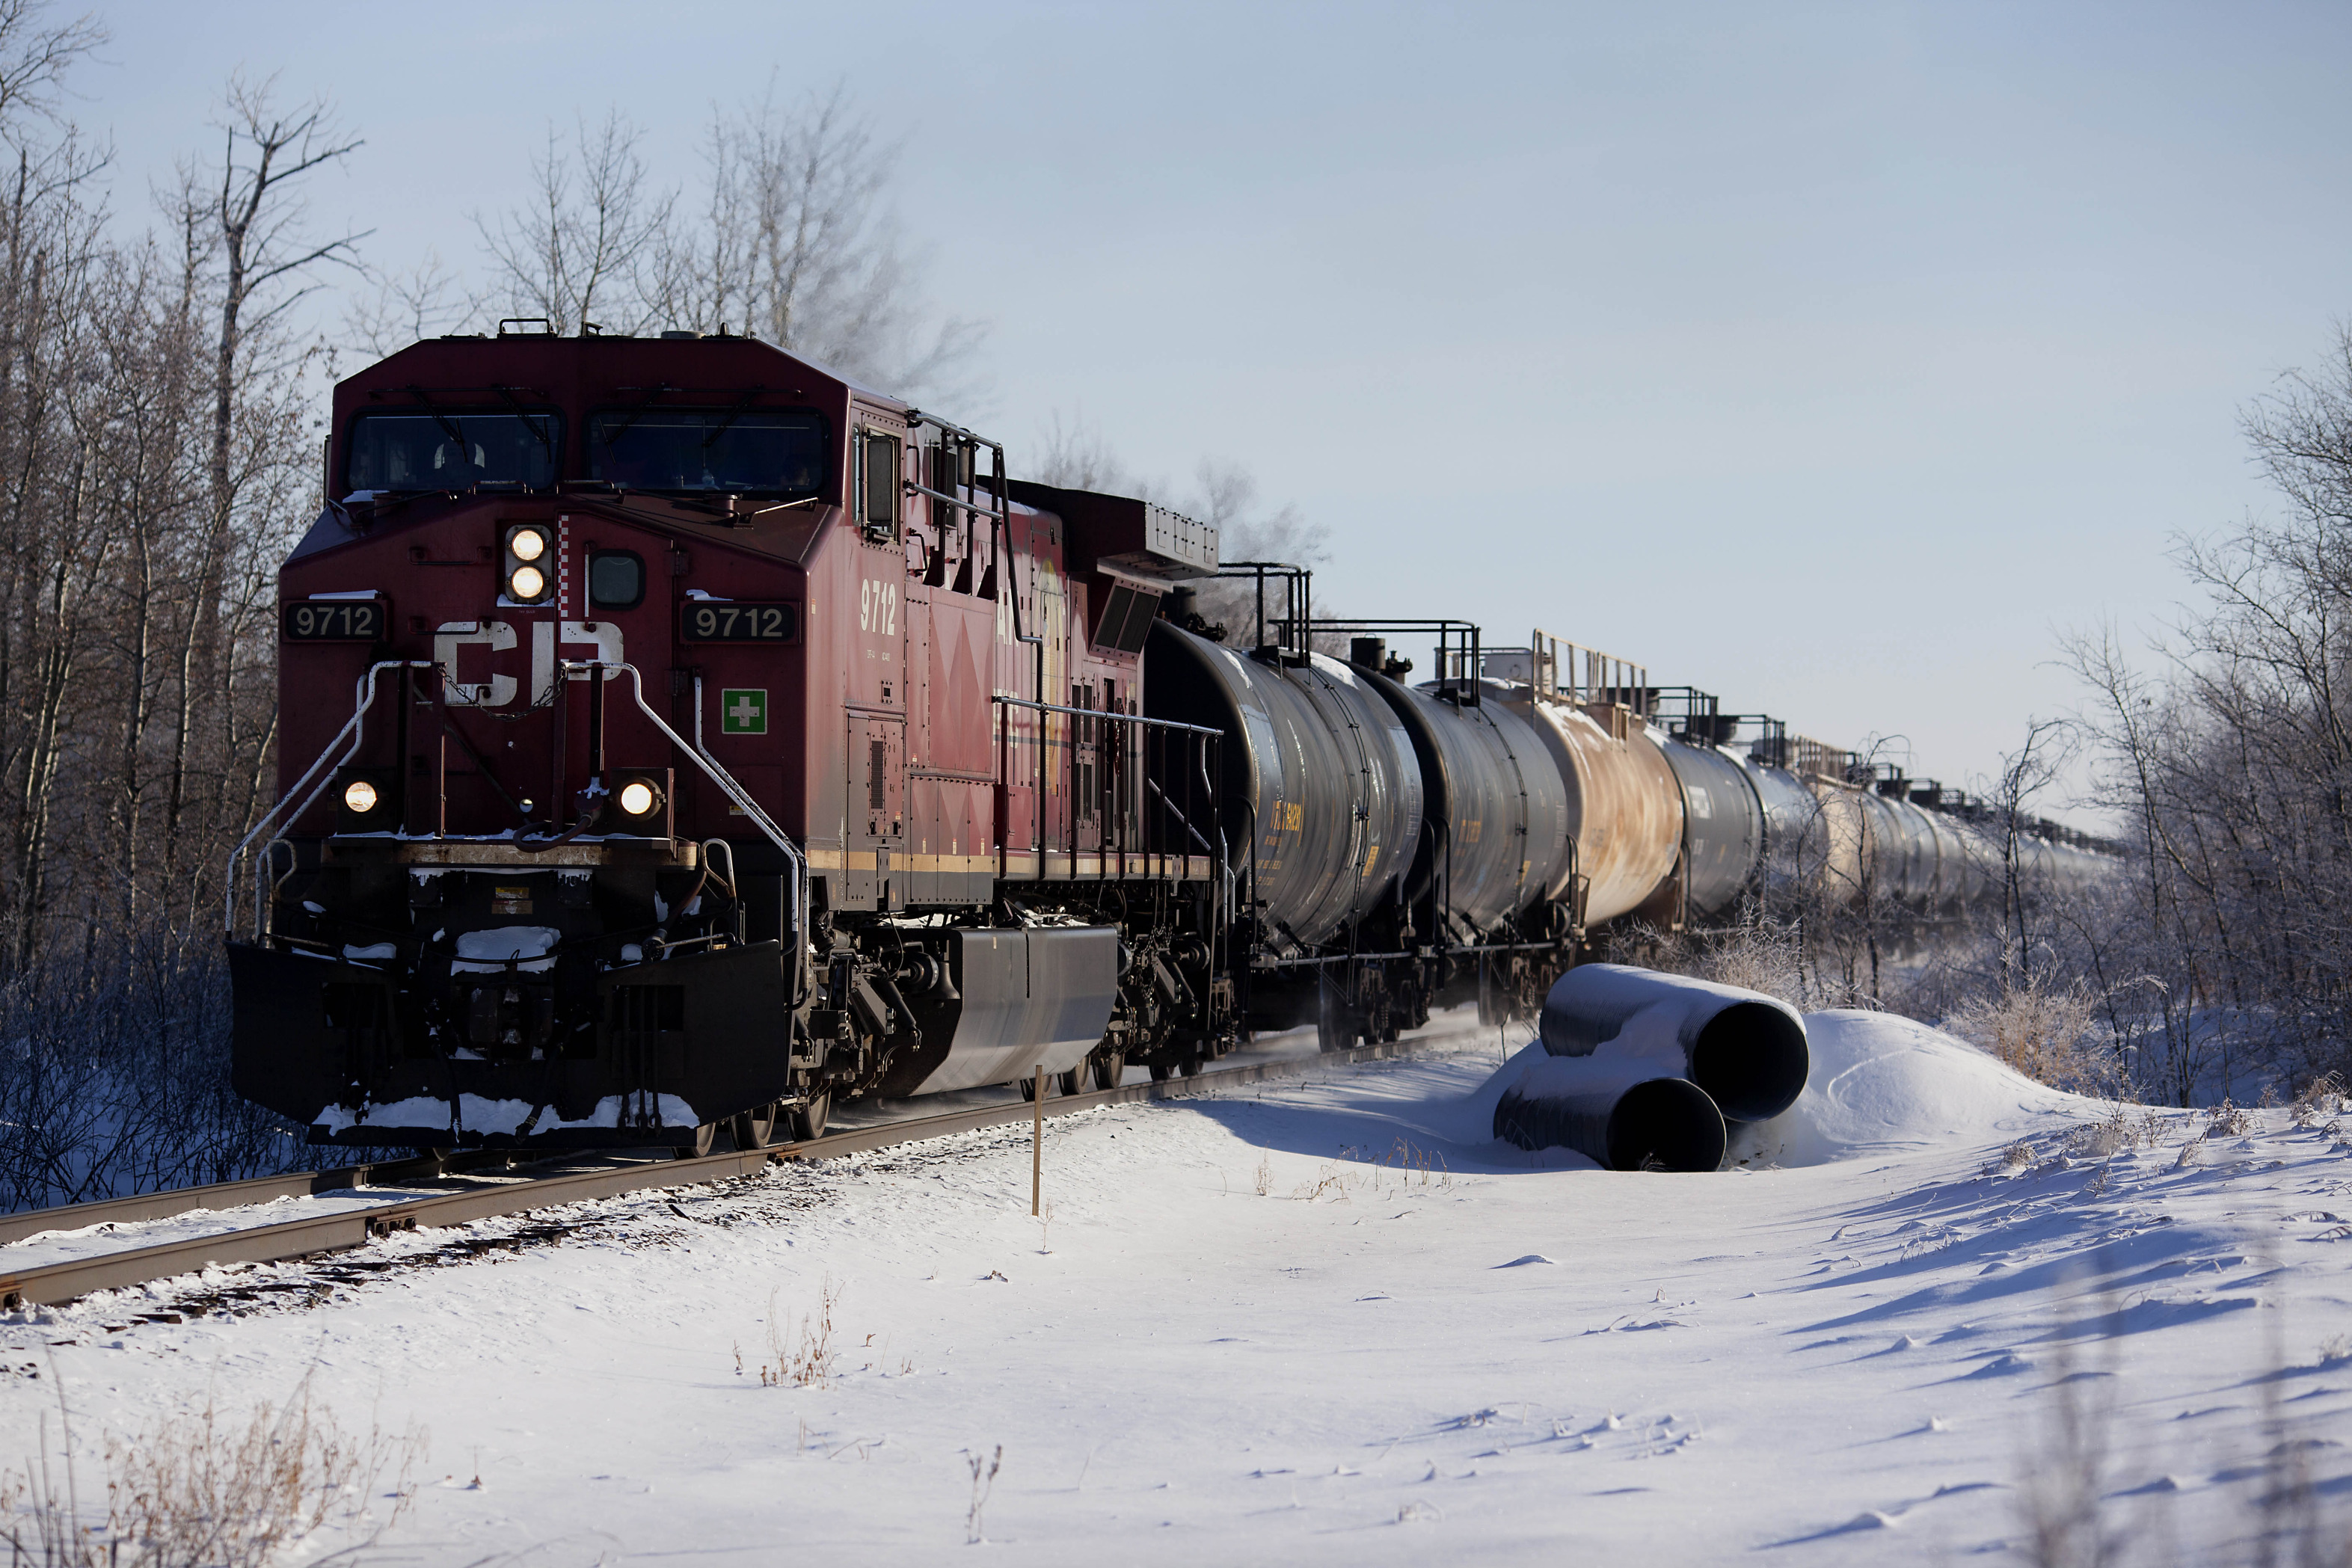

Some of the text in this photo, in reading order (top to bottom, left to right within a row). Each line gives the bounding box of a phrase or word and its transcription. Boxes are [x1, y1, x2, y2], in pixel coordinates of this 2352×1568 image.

[297, 607, 372, 636] 9712
[696, 609, 782, 636] 9712
[861, 579, 895, 636] 9712
[435, 621, 624, 707] CP
